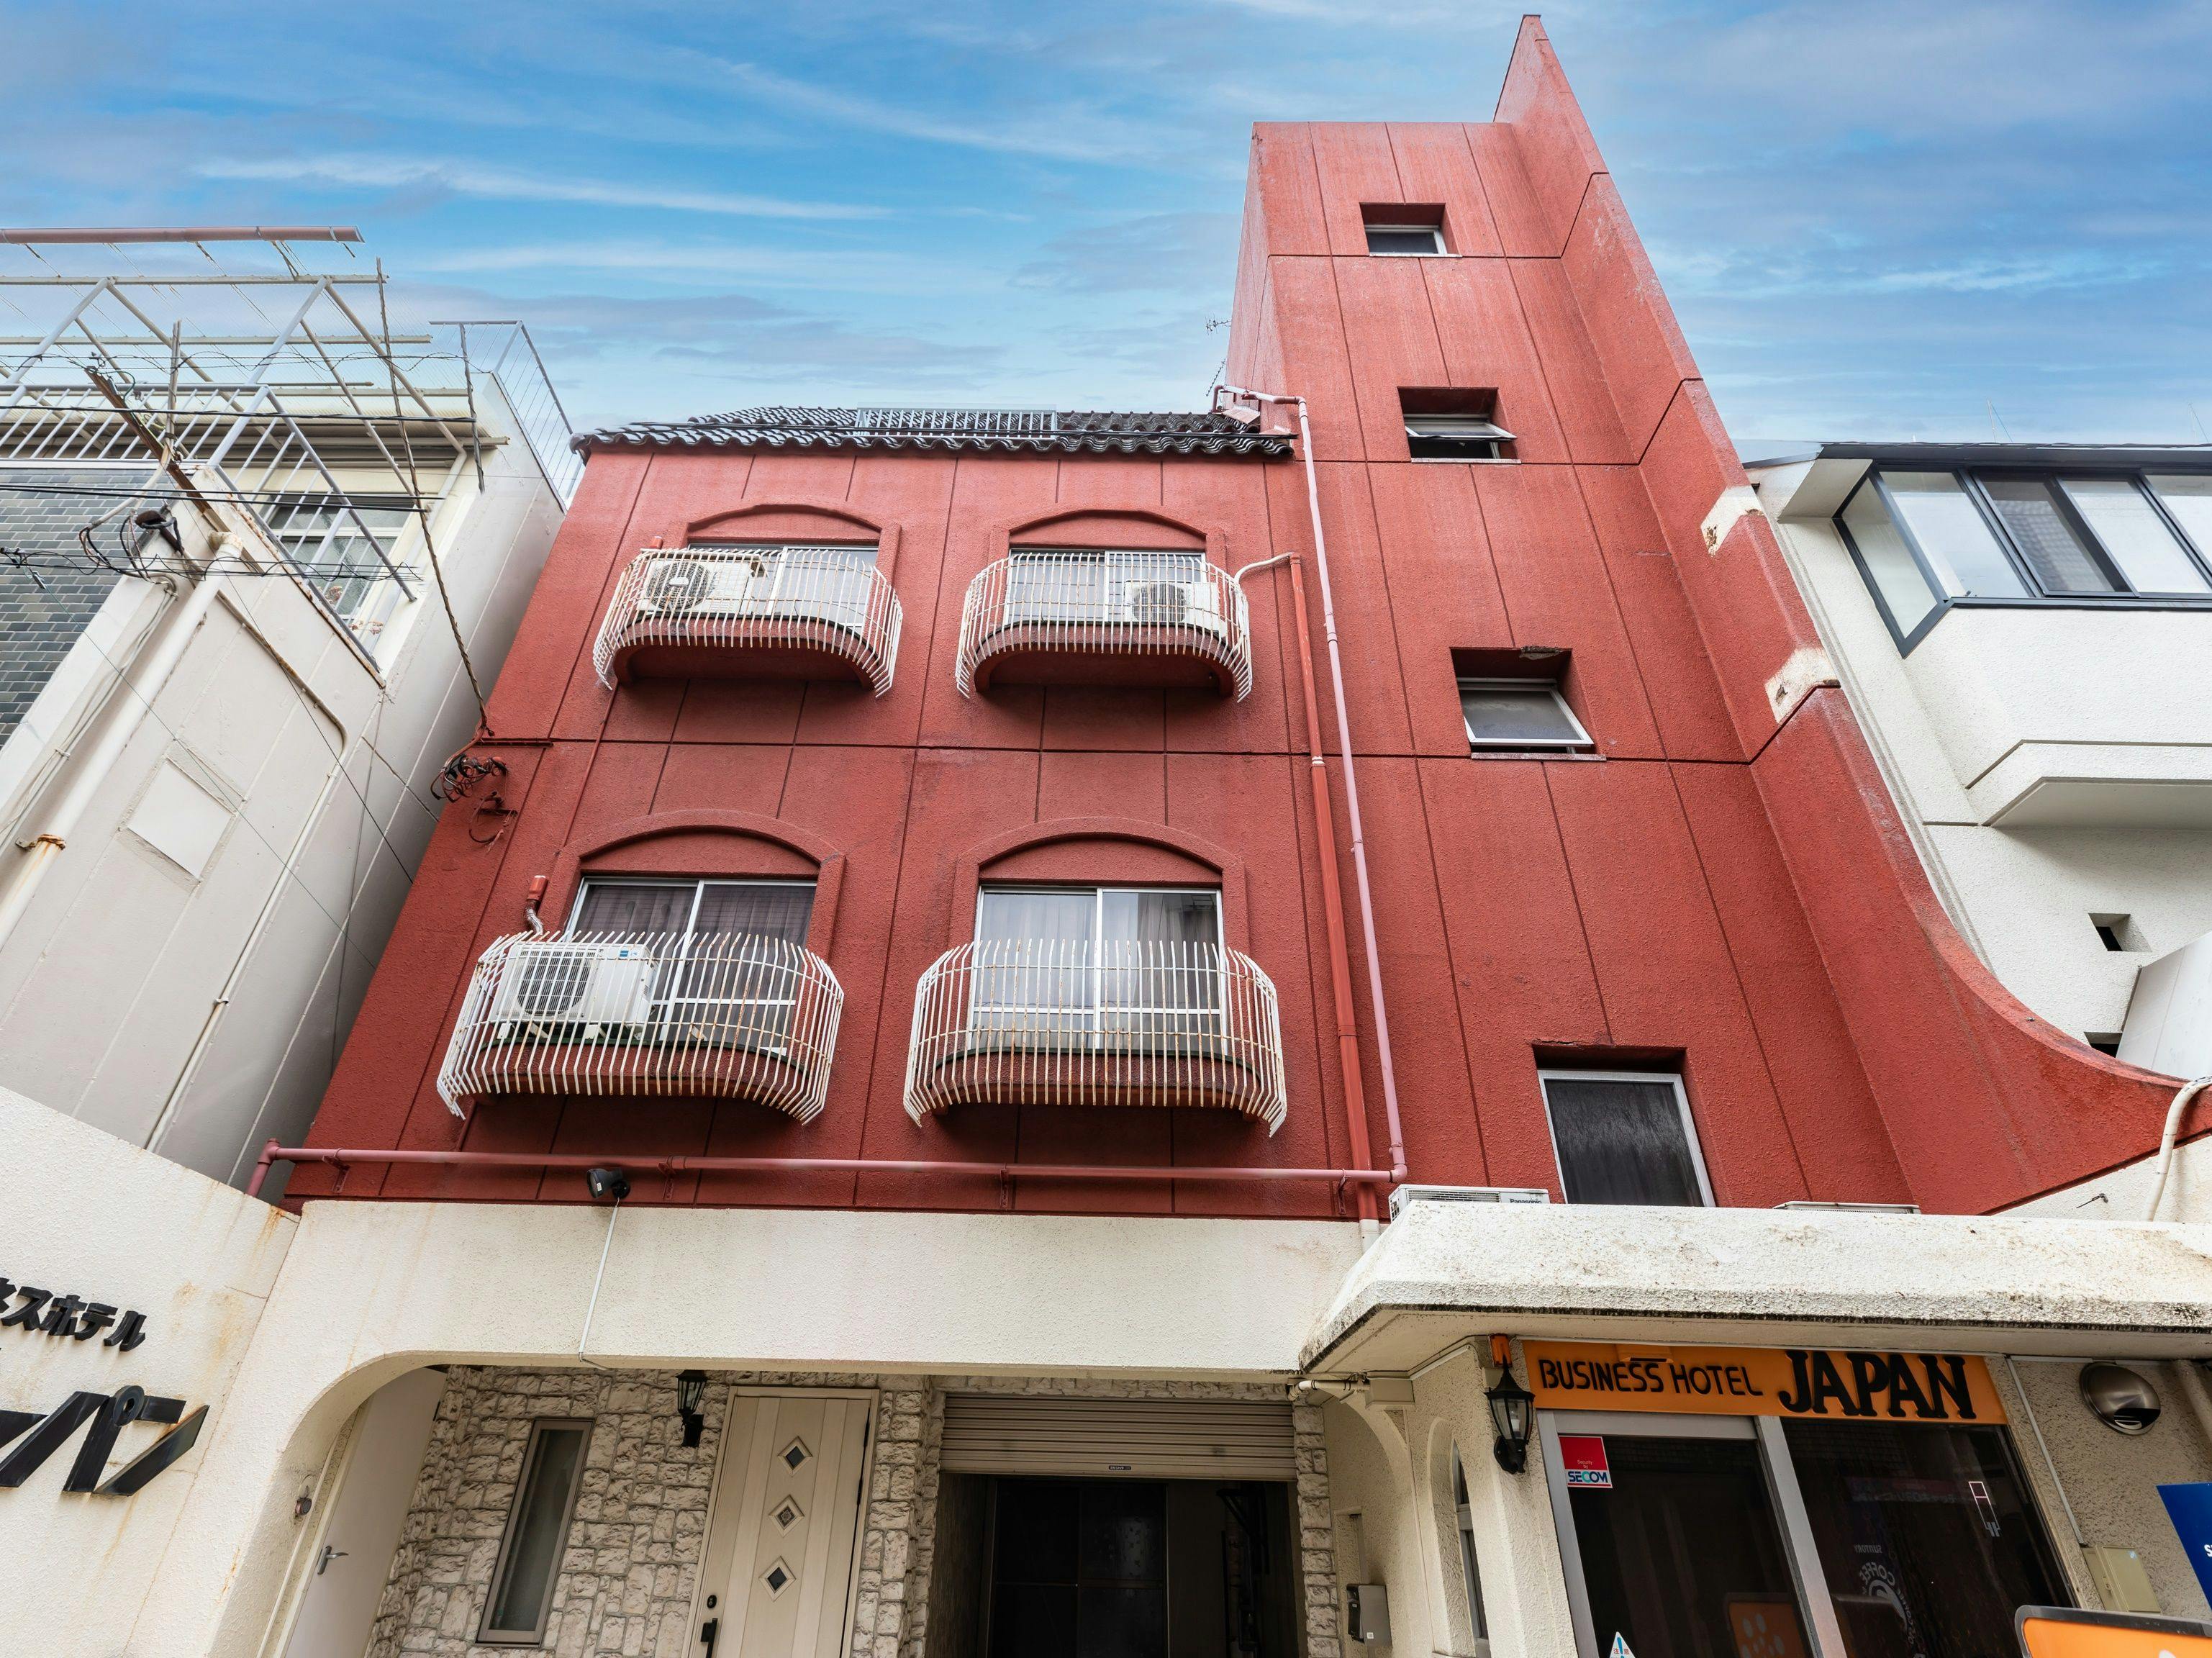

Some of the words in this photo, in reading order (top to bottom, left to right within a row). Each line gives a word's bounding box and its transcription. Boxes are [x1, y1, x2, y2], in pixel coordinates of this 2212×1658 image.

[1538, 1359, 1664, 1392] BUSINESS
[1671, 1364, 1763, 1396] HOTEL
[1778, 1350, 1977, 1418] JAPAN
[0, 1385, 210, 1496] パン
[1567, 1471, 1608, 1483] SECOM
